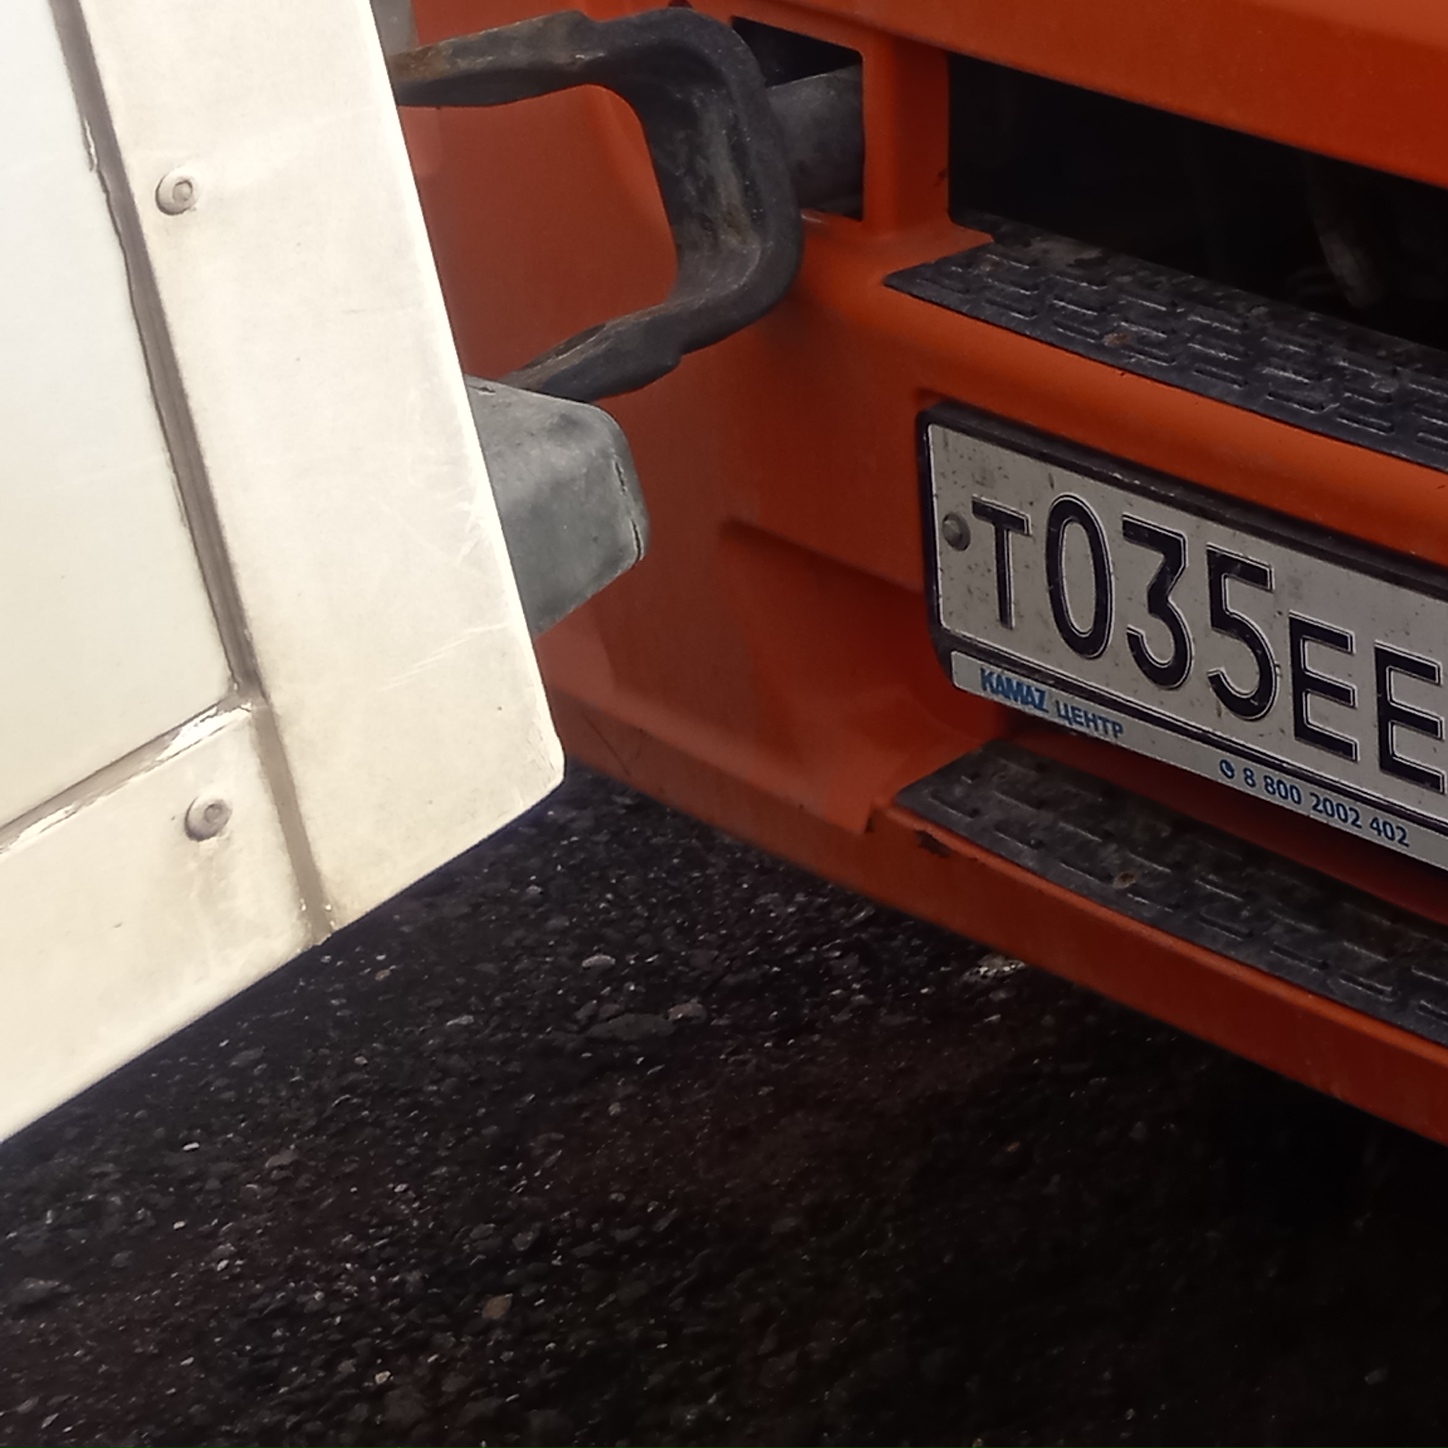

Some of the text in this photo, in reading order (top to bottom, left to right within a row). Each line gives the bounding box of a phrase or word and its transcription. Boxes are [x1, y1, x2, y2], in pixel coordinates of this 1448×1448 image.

[979, 667, 1124, 739] KAMAZ ЦЕНТР
[1243, 767, 1410, 848] 8 800 2002 402
